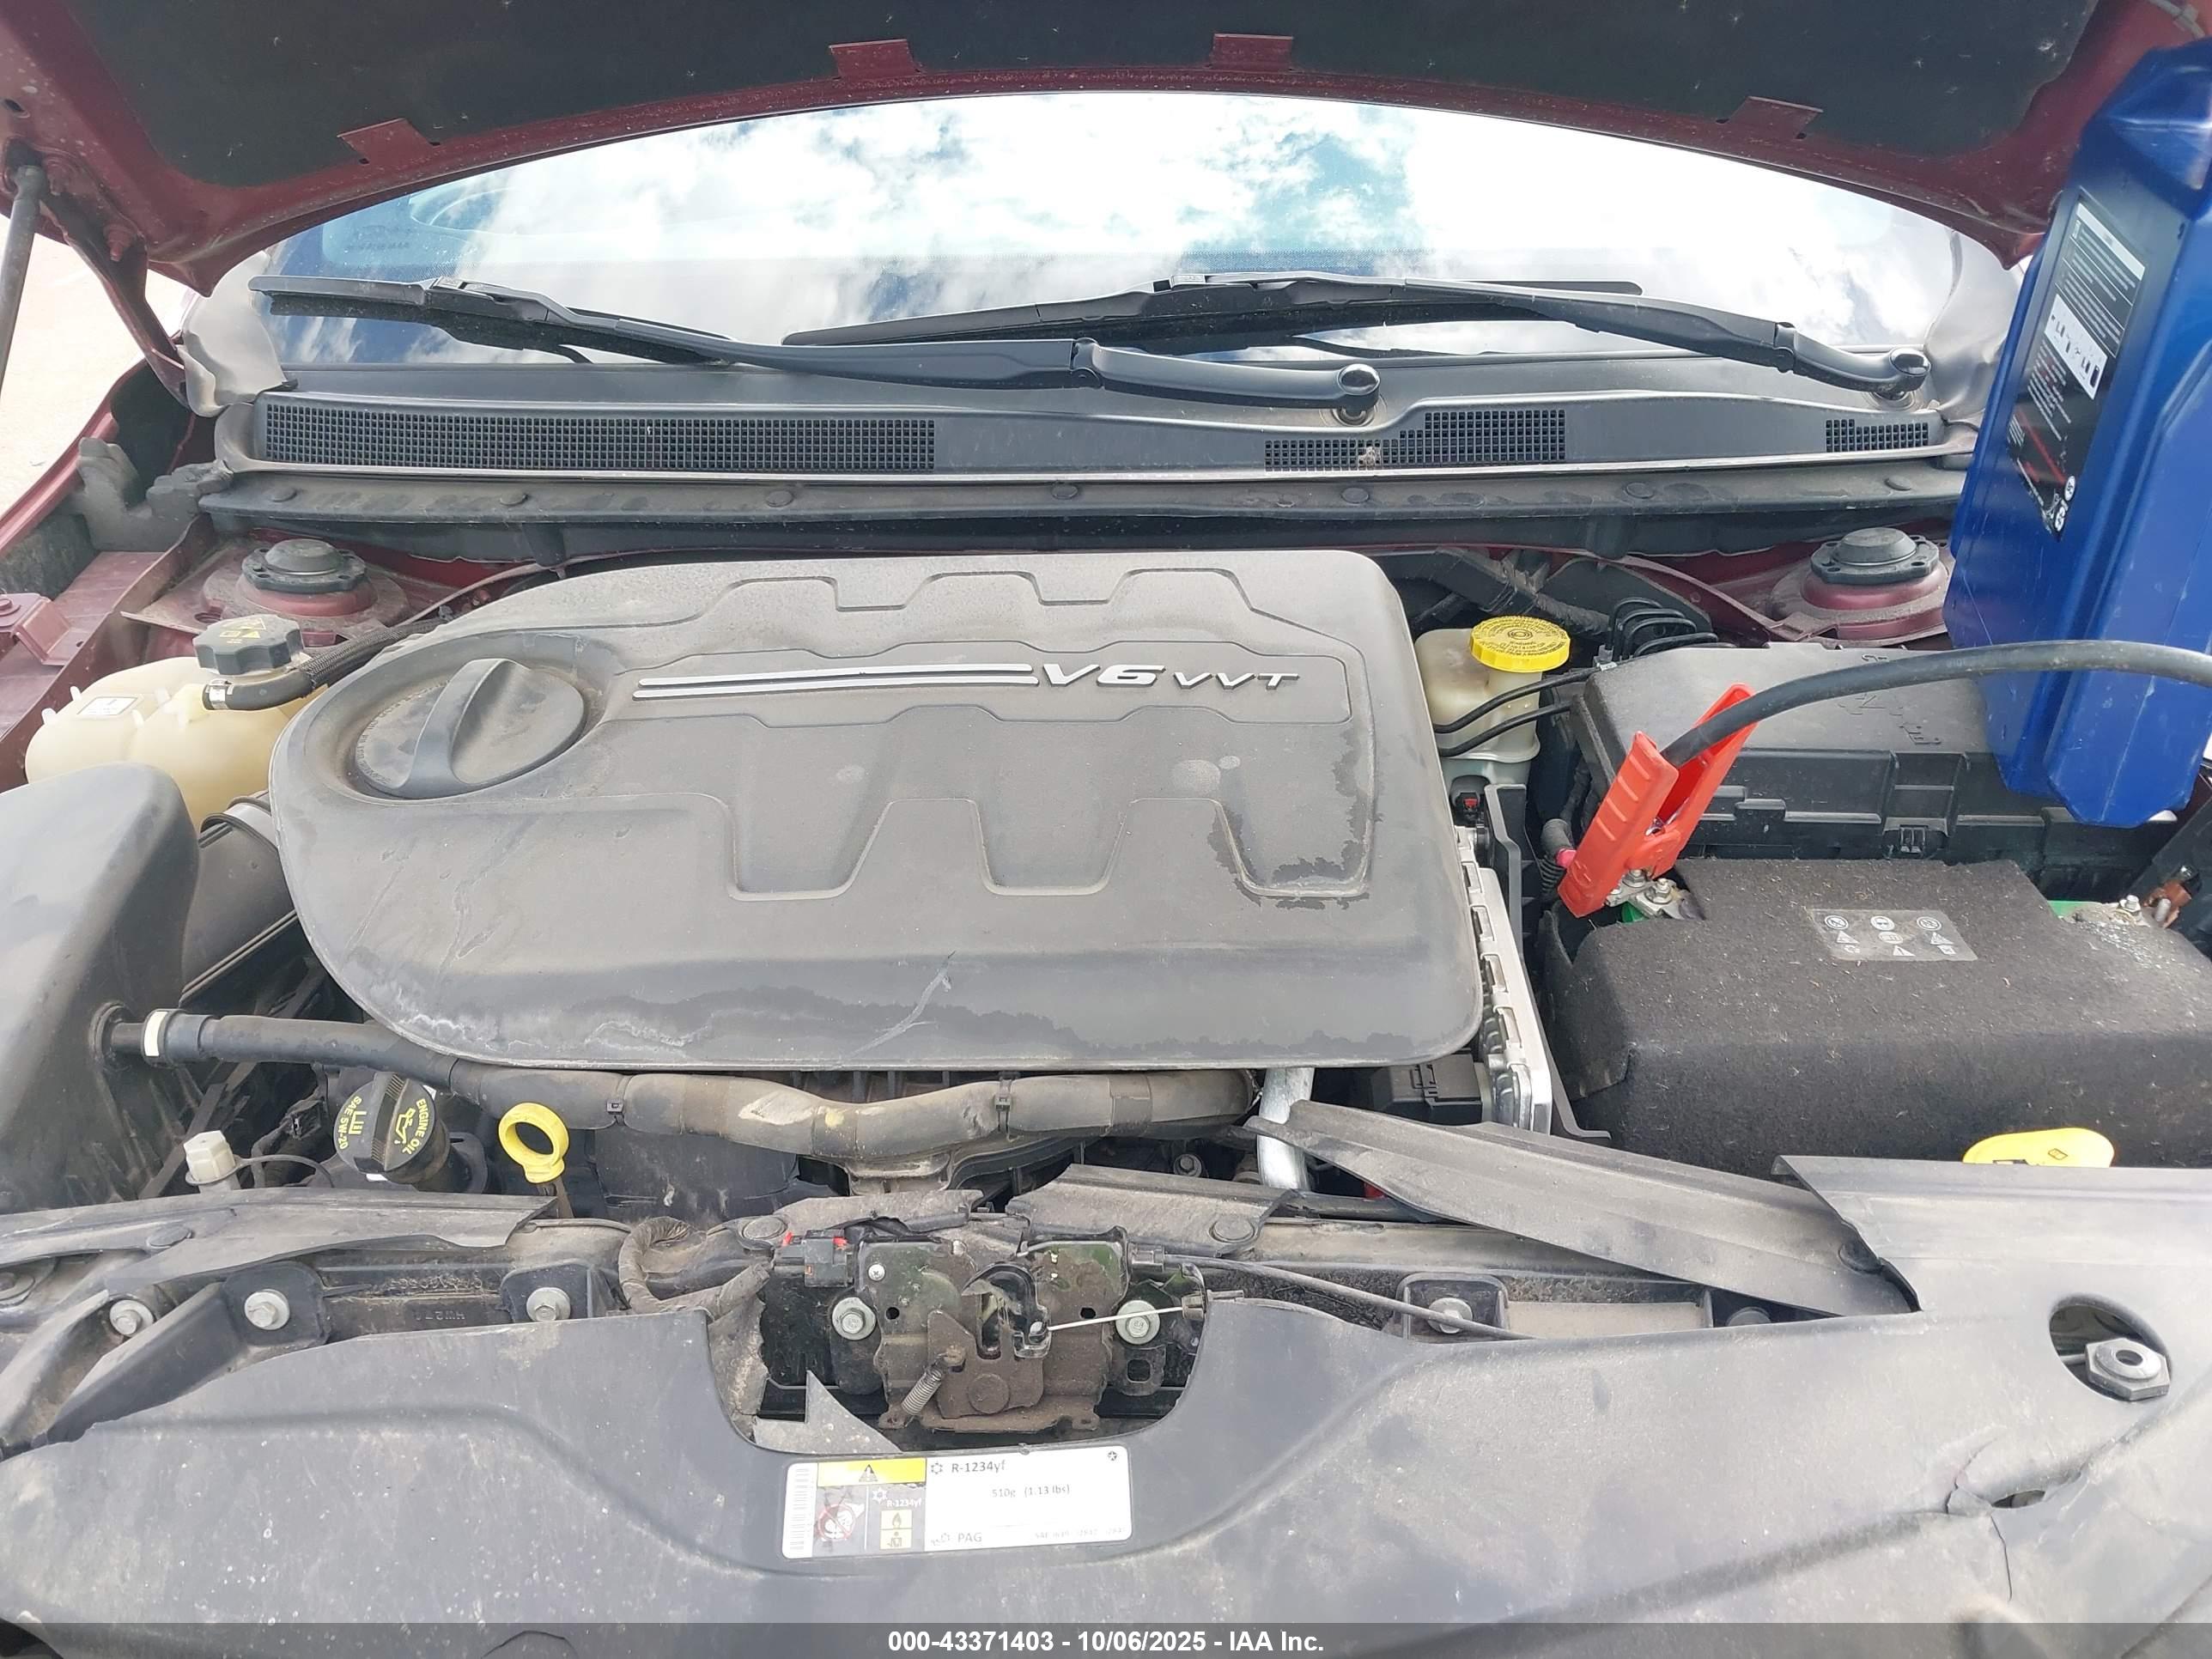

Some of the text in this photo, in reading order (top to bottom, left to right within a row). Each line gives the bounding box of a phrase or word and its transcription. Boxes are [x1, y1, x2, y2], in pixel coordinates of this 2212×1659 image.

[1042, 663, 1300, 690] V6 VVT
[337, 1095, 363, 1151] SAE 5W-20
[401, 1097, 430, 1155] ENGINE OIL
[951, 1459, 1006, 1474] R-1234yf
[1024, 1486, 1049, 1498] (1.13
[1051, 1484, 1072, 1495] lbs)
[886, 1498, 922, 1509] R-1234yf
[957, 1531, 983, 1544] PAG
